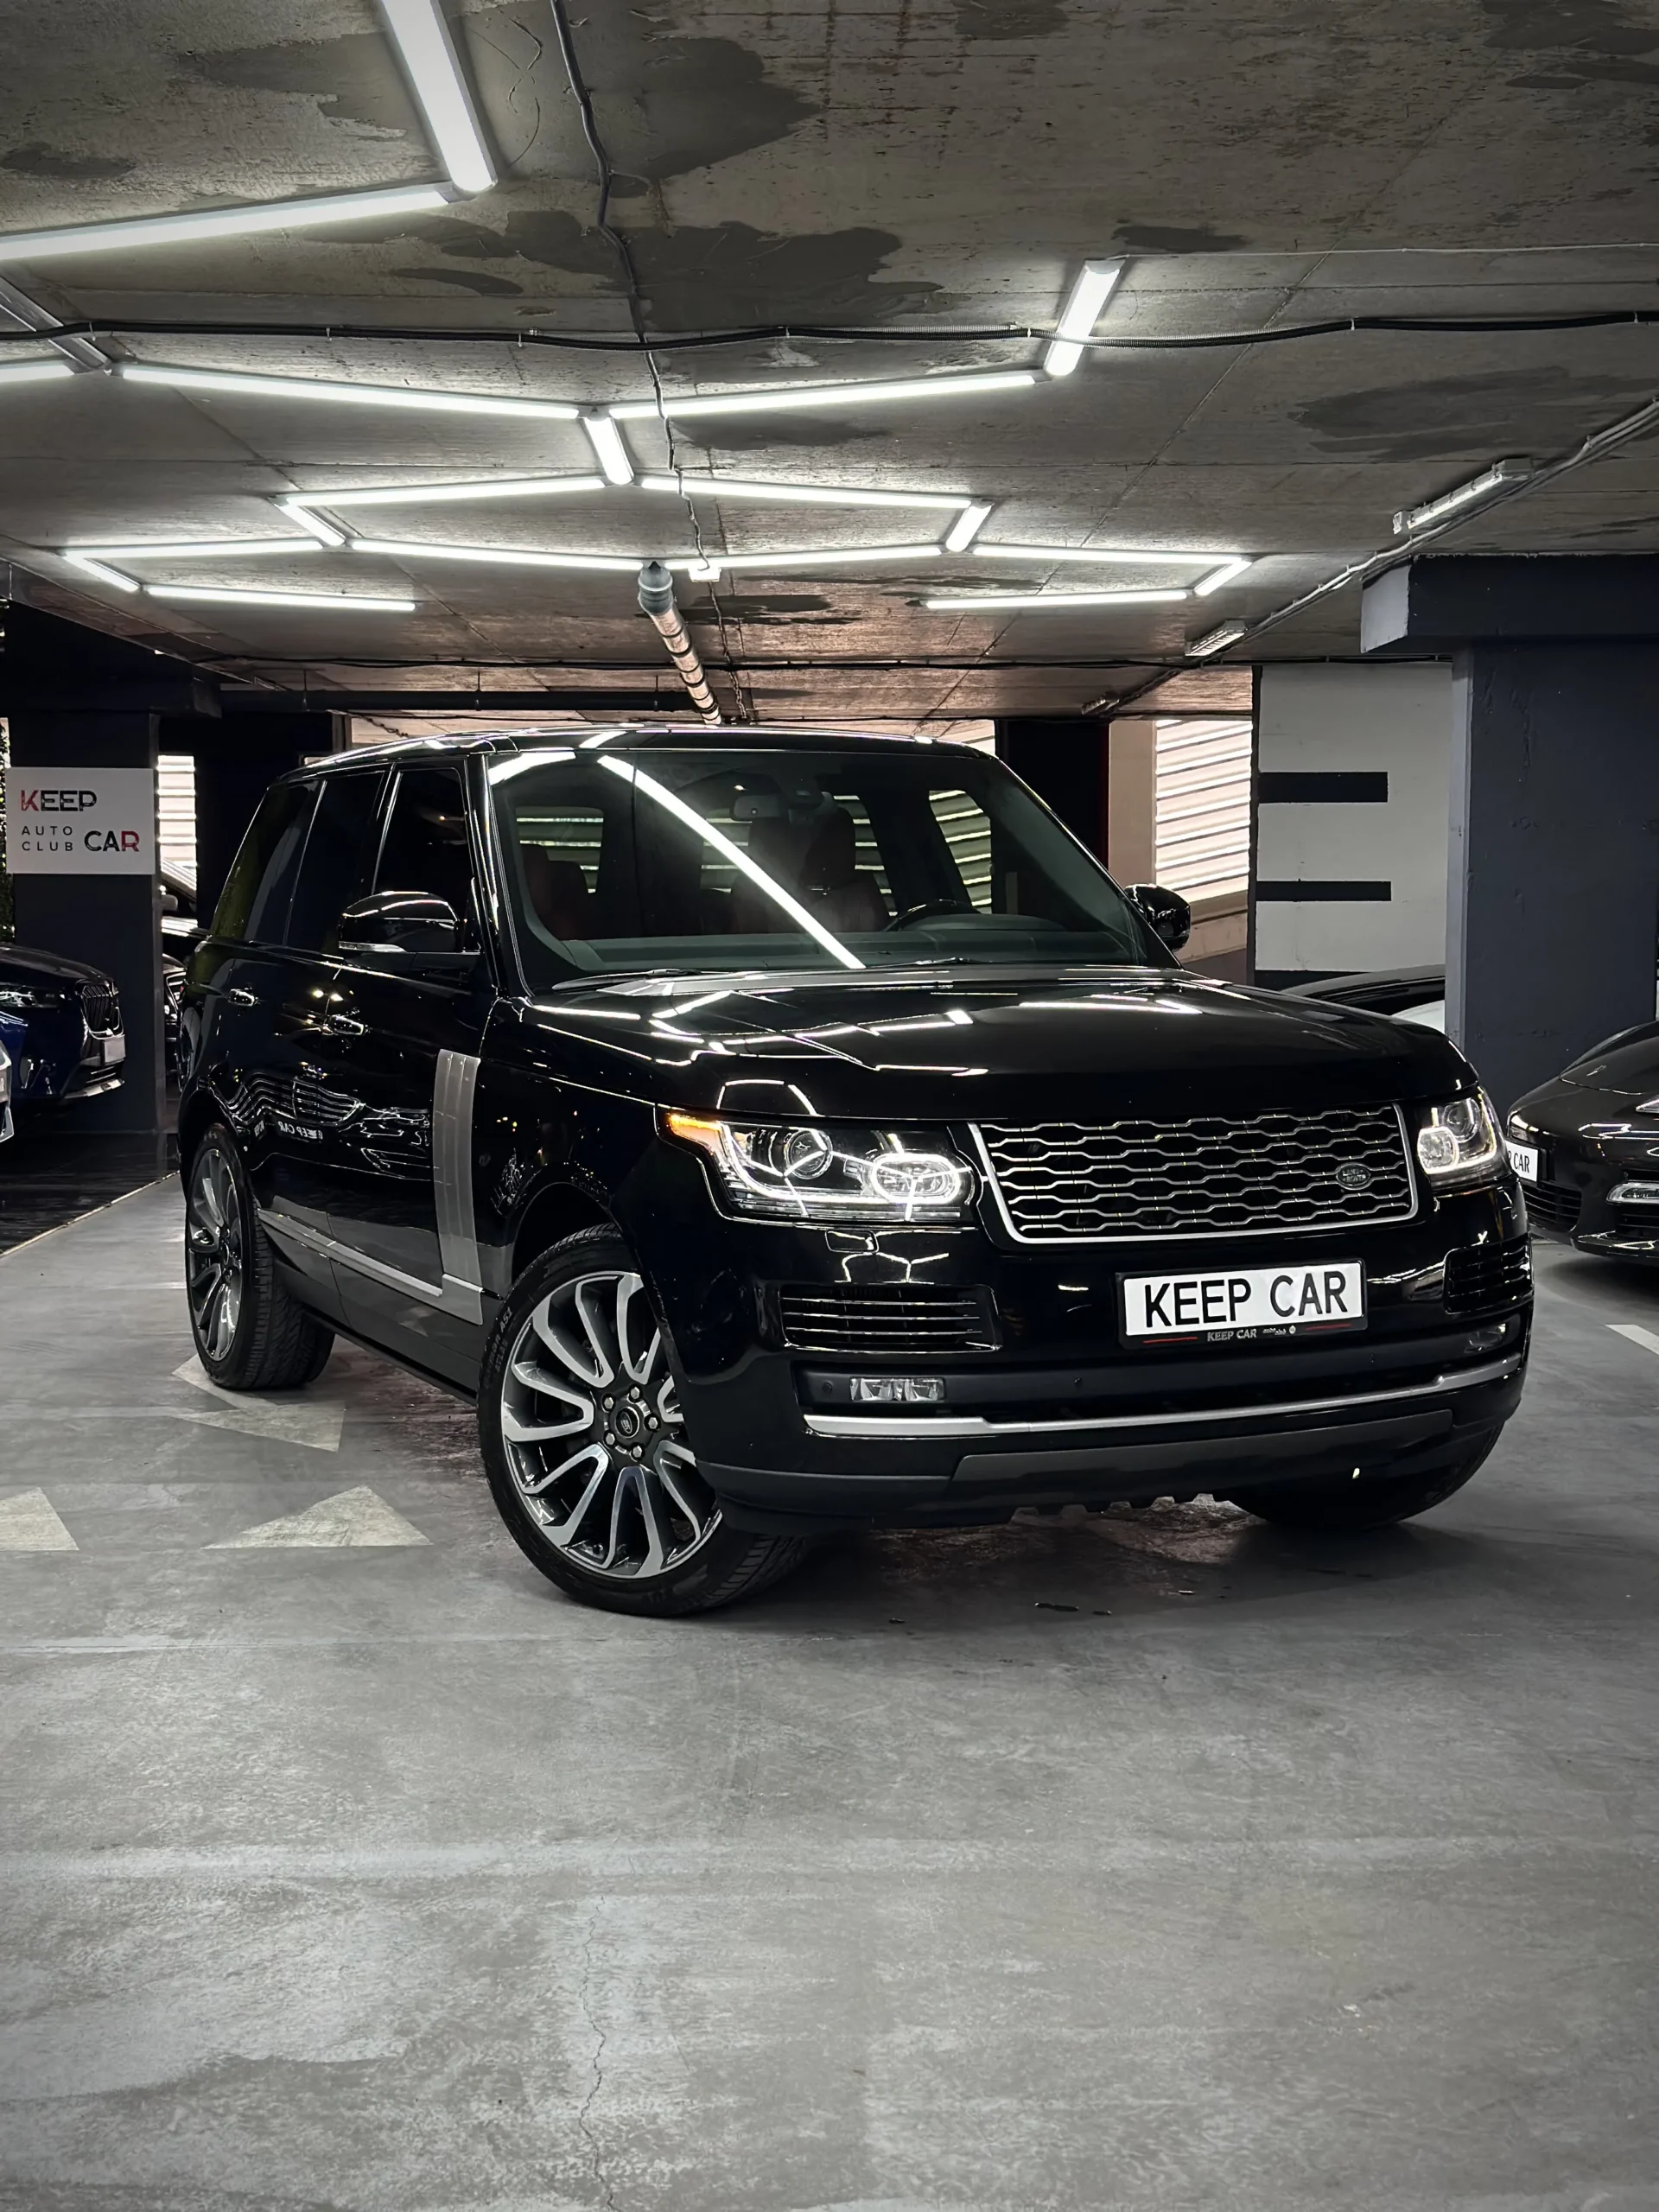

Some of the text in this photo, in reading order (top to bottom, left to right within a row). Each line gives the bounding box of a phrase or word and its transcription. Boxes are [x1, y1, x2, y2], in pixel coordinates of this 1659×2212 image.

[21, 789, 98, 811] KEEP
[21, 825, 73, 836] AUTO
[84, 830, 140, 852] CAR
[22, 842, 73, 851] CLUB
[1514, 1152, 1530, 1173] CAR
[1144, 1270, 1348, 1328] KEEP CAR
[1207, 1331, 1234, 1342] KEEP
[1236, 1328, 1257, 1339] CAR
